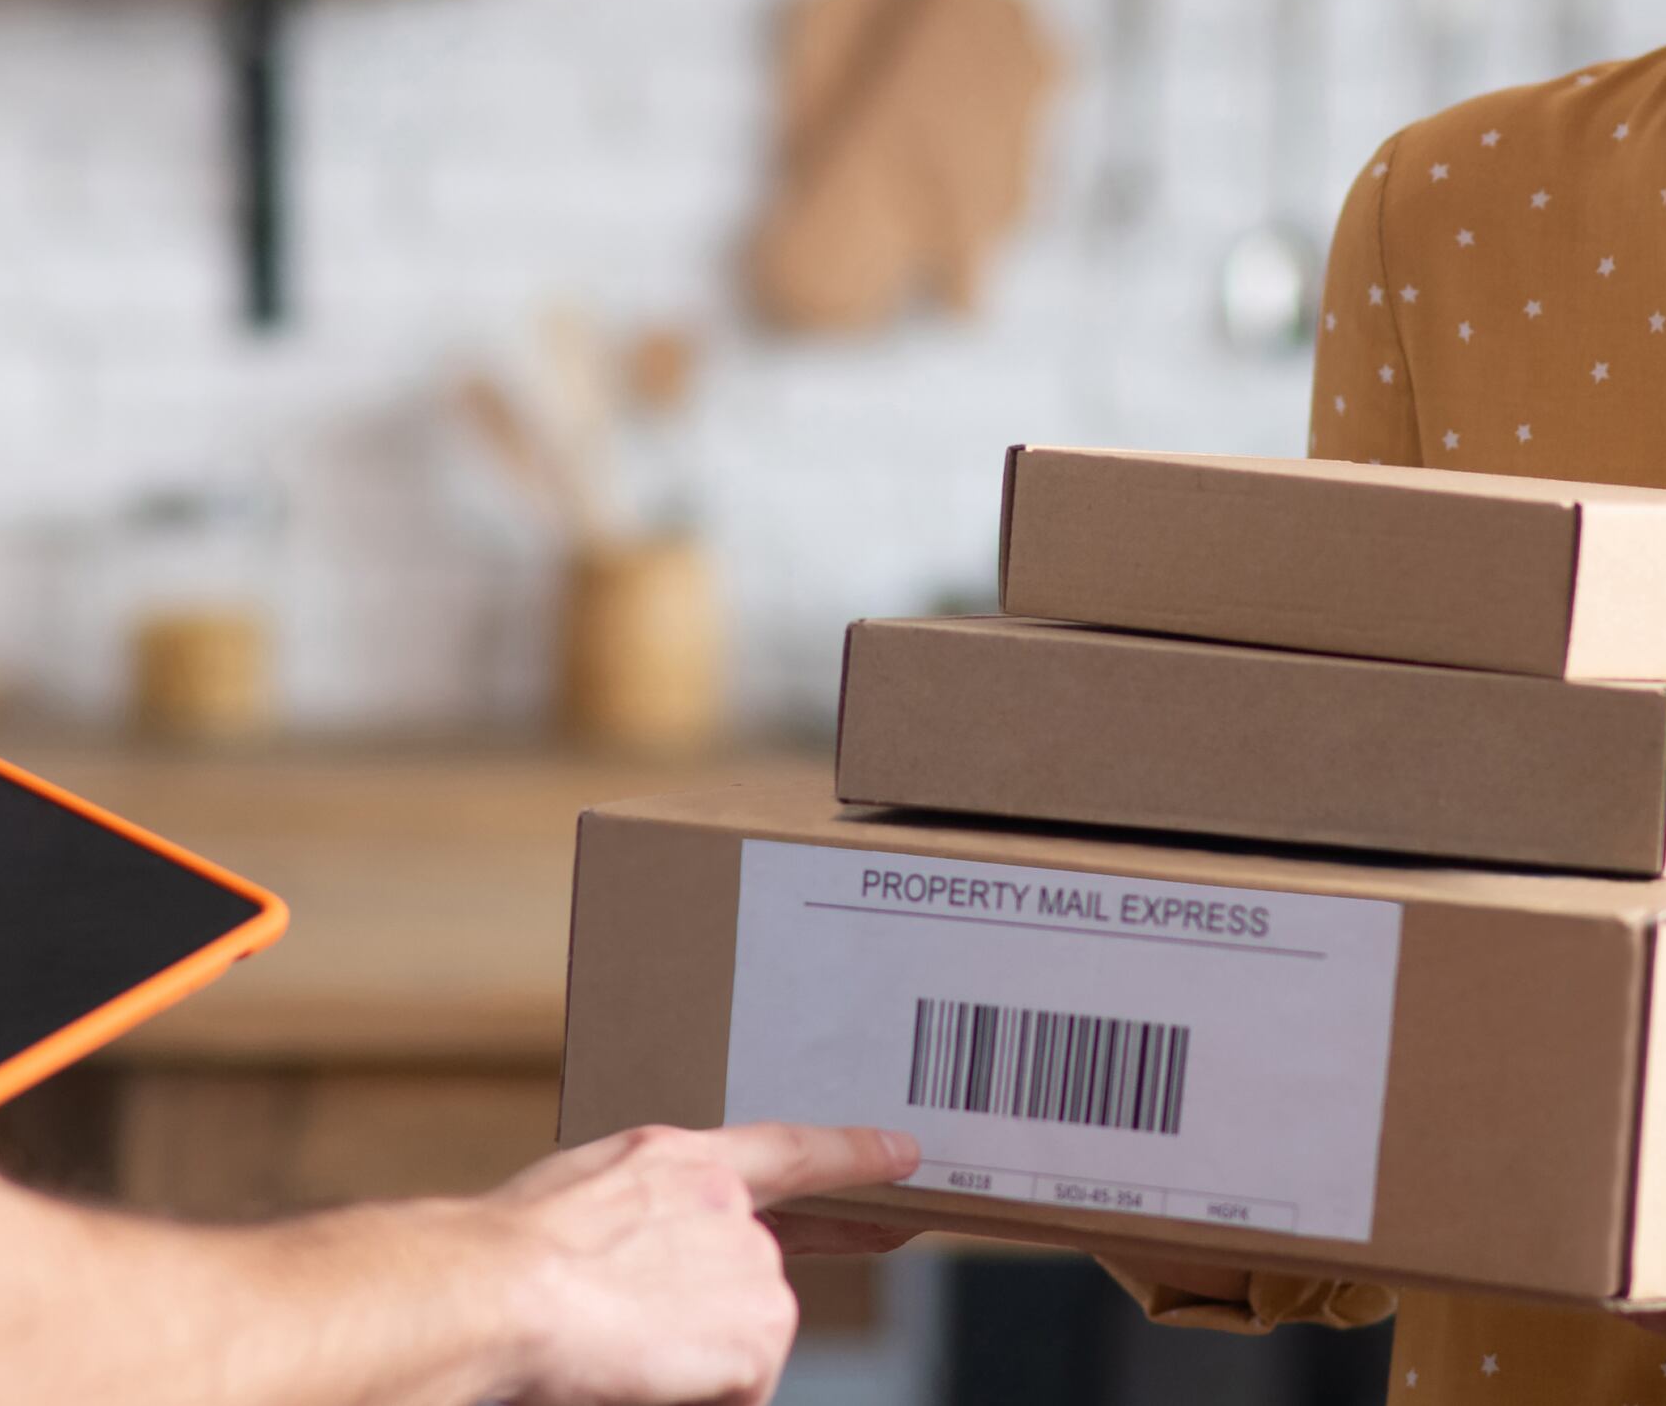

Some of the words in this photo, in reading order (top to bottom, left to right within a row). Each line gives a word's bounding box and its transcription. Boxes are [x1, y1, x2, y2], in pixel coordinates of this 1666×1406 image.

[861, 869, 1030, 913] PROPERTY
[1037, 887, 1109, 923] MAIL
[1120, 893, 1271, 938] EXPRESS
